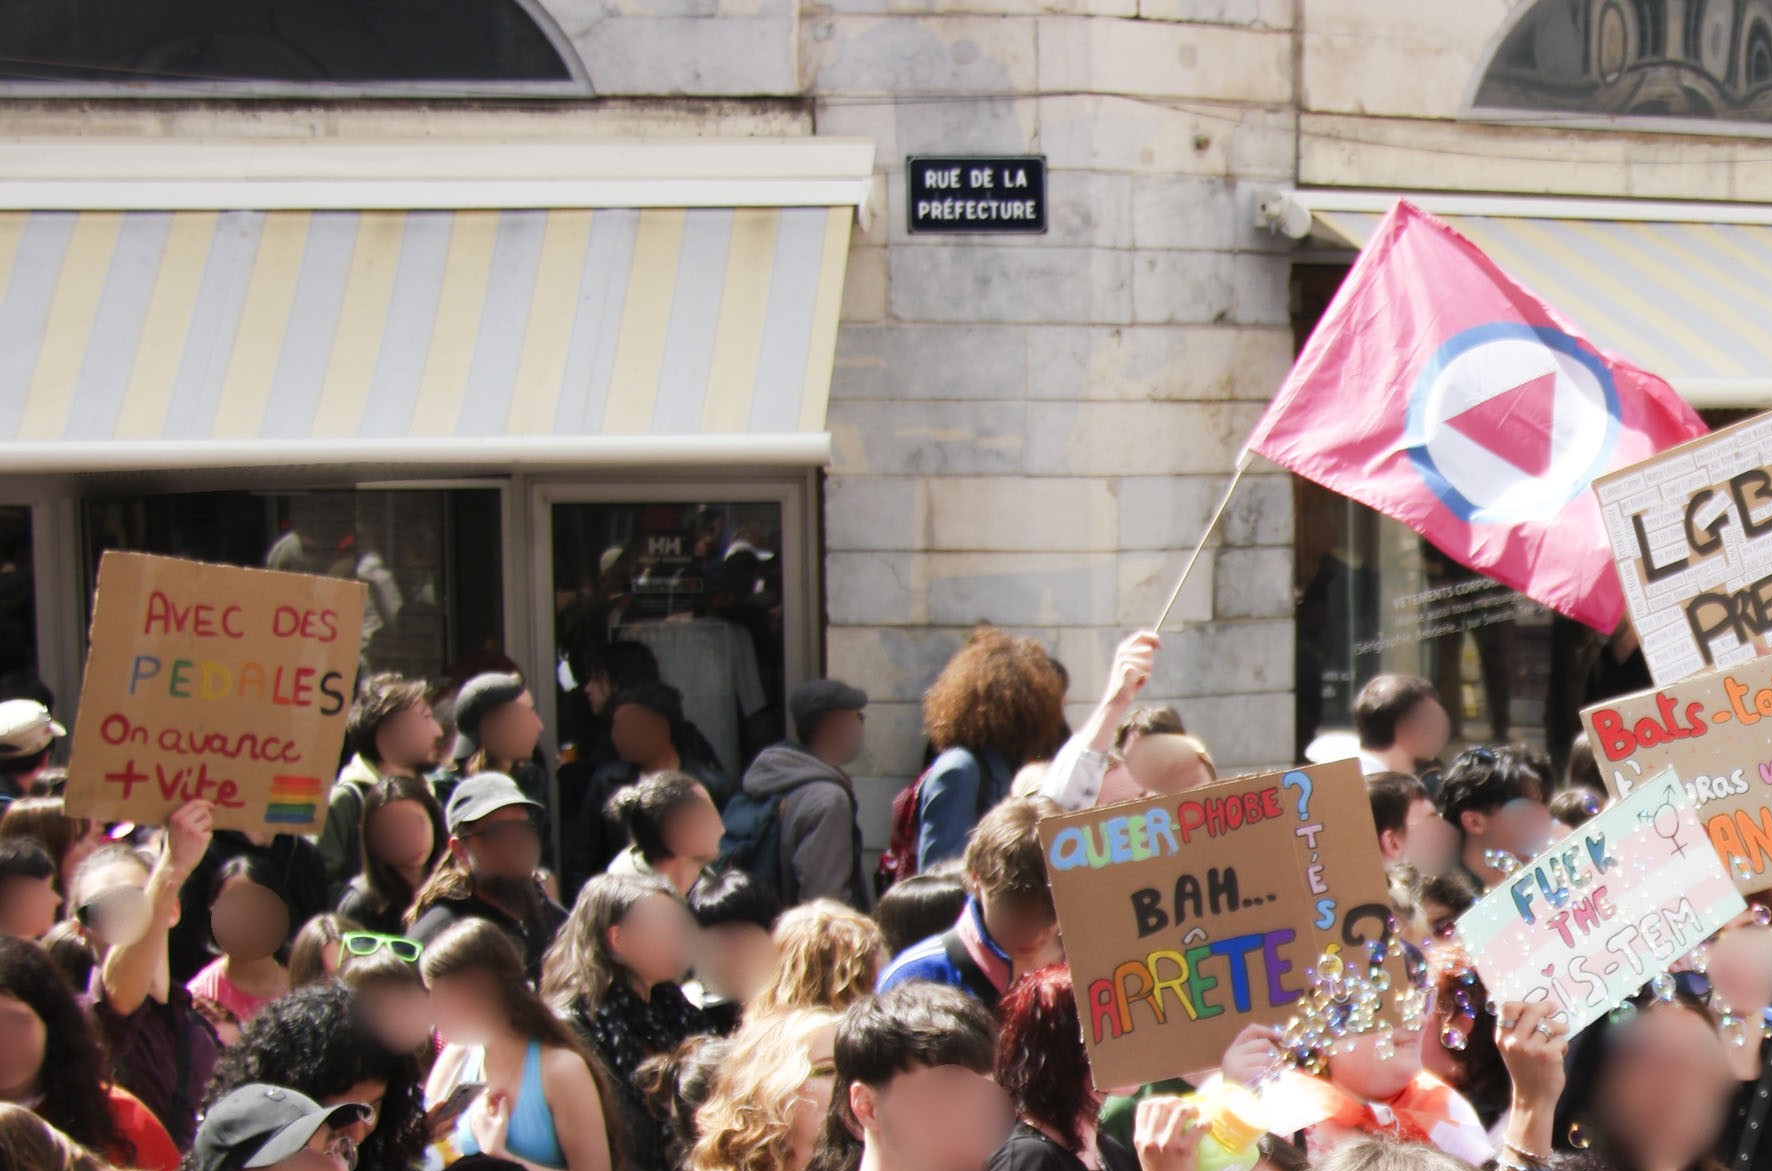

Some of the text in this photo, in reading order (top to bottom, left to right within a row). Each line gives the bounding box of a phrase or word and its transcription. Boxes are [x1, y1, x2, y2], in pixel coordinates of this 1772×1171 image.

[918, 197, 1036, 220] PRÉFECTURE
[925, 168, 1027, 188] RUE DE LA
[144, 591, 339, 643] AVEC DES
[128, 655, 345, 716] PEDALES
[101, 713, 301, 763] On avance
[1131, 867, 1276, 938] BAH...
[1511, 832, 1618, 926] FUCK
[1547, 885, 1617, 949] THE
[1088, 928, 1304, 1045] ARRÊTE
